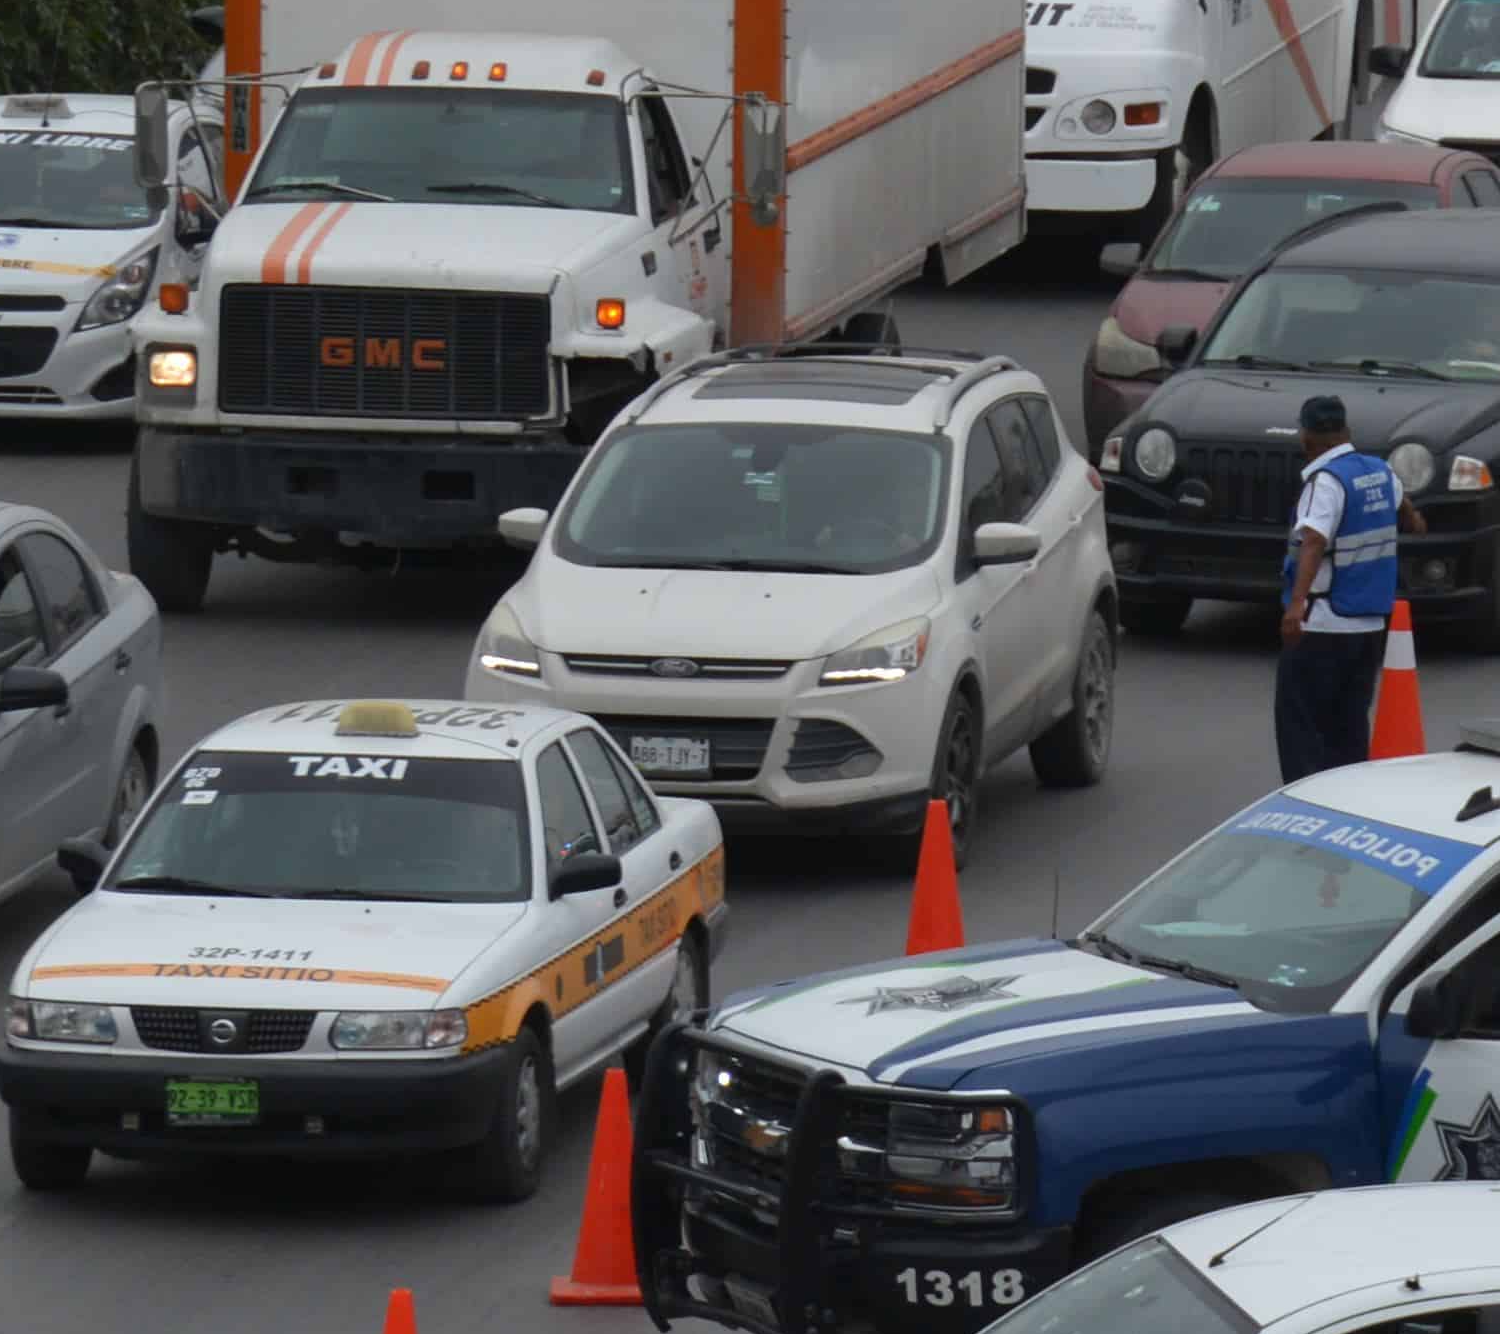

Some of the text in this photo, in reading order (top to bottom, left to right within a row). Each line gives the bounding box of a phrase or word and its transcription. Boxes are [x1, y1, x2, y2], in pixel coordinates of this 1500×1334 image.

[32, 133, 136, 152] LIBRE
[321, 337, 447, 371] GMC
[288, 756, 409, 780] TAXI
[187, 946, 313, 962] 32P-1411
[153, 963, 335, 983] TAXI SITIO
[897, 1267, 1025, 1307] 1318
